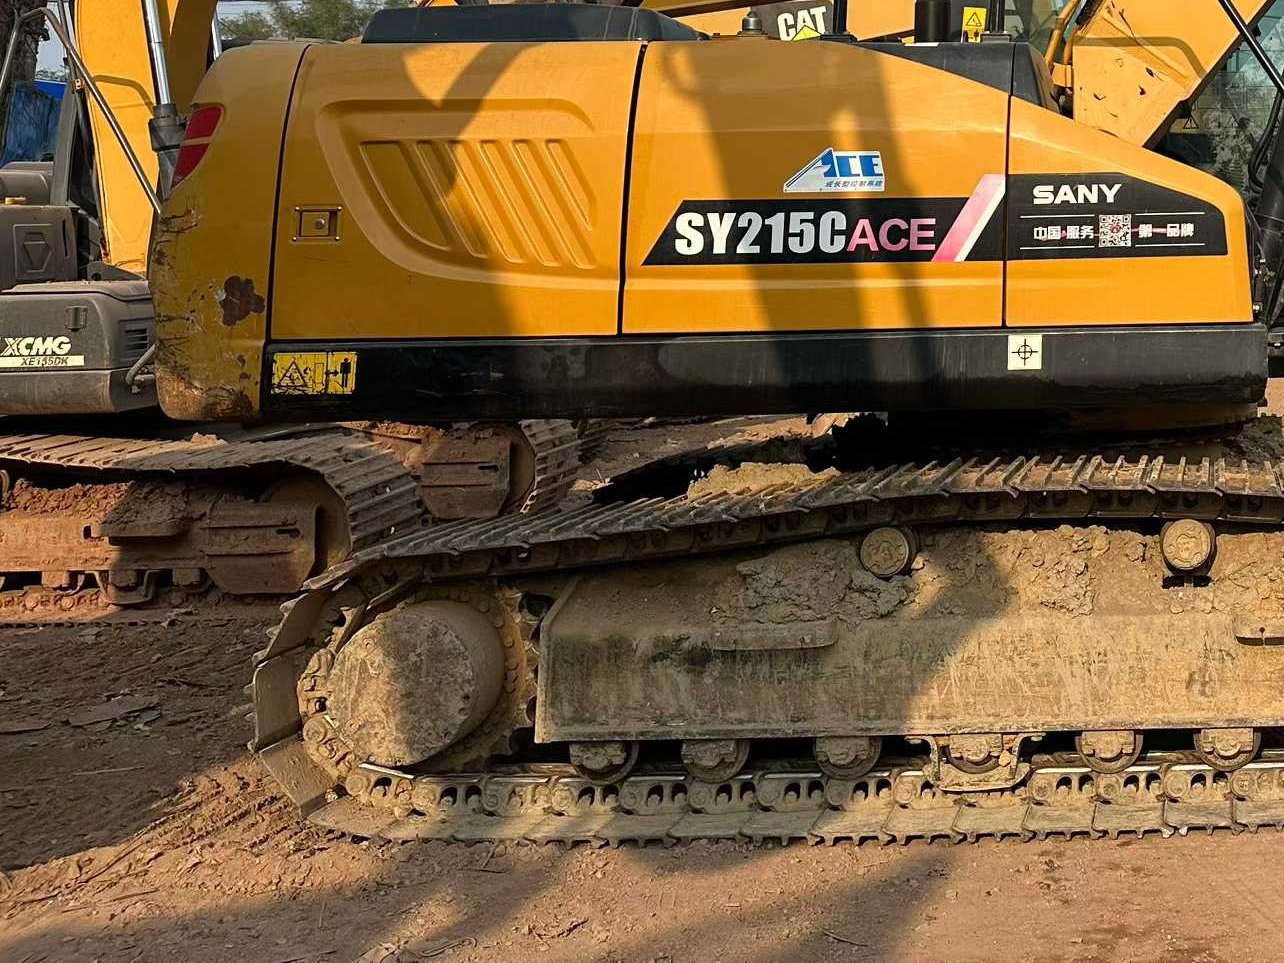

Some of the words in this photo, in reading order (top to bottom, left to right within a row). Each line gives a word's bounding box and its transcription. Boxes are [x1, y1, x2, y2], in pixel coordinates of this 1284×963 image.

[777, 5, 827, 41] CAT
[803, 149, 883, 178] ACE
[1033, 184, 1122, 205] SANY
[0, 336, 72, 356] XCMG
